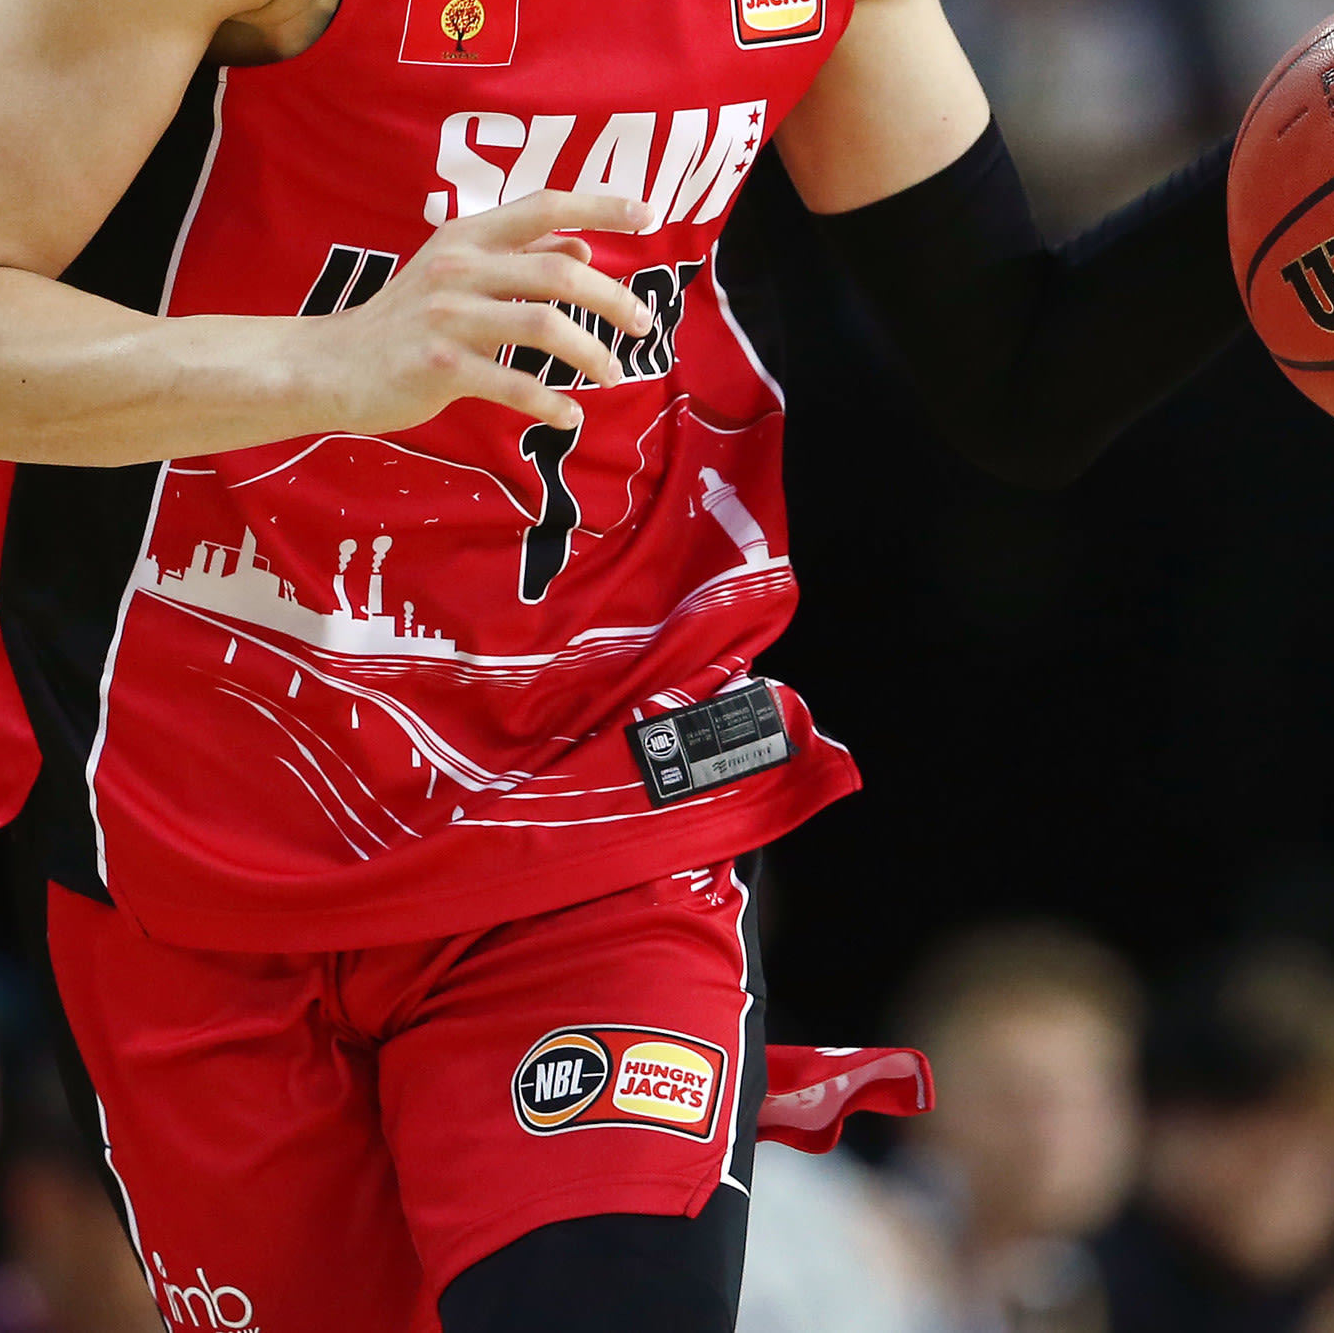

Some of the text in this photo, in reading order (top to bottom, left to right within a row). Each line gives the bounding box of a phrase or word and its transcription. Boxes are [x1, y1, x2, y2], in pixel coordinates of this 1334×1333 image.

[424, 99, 767, 236] SLAM
[534, 1057, 584, 1104] NBL
[619, 1077, 704, 1109] JACK'S
[624, 1060, 709, 1089] HUNGRY
